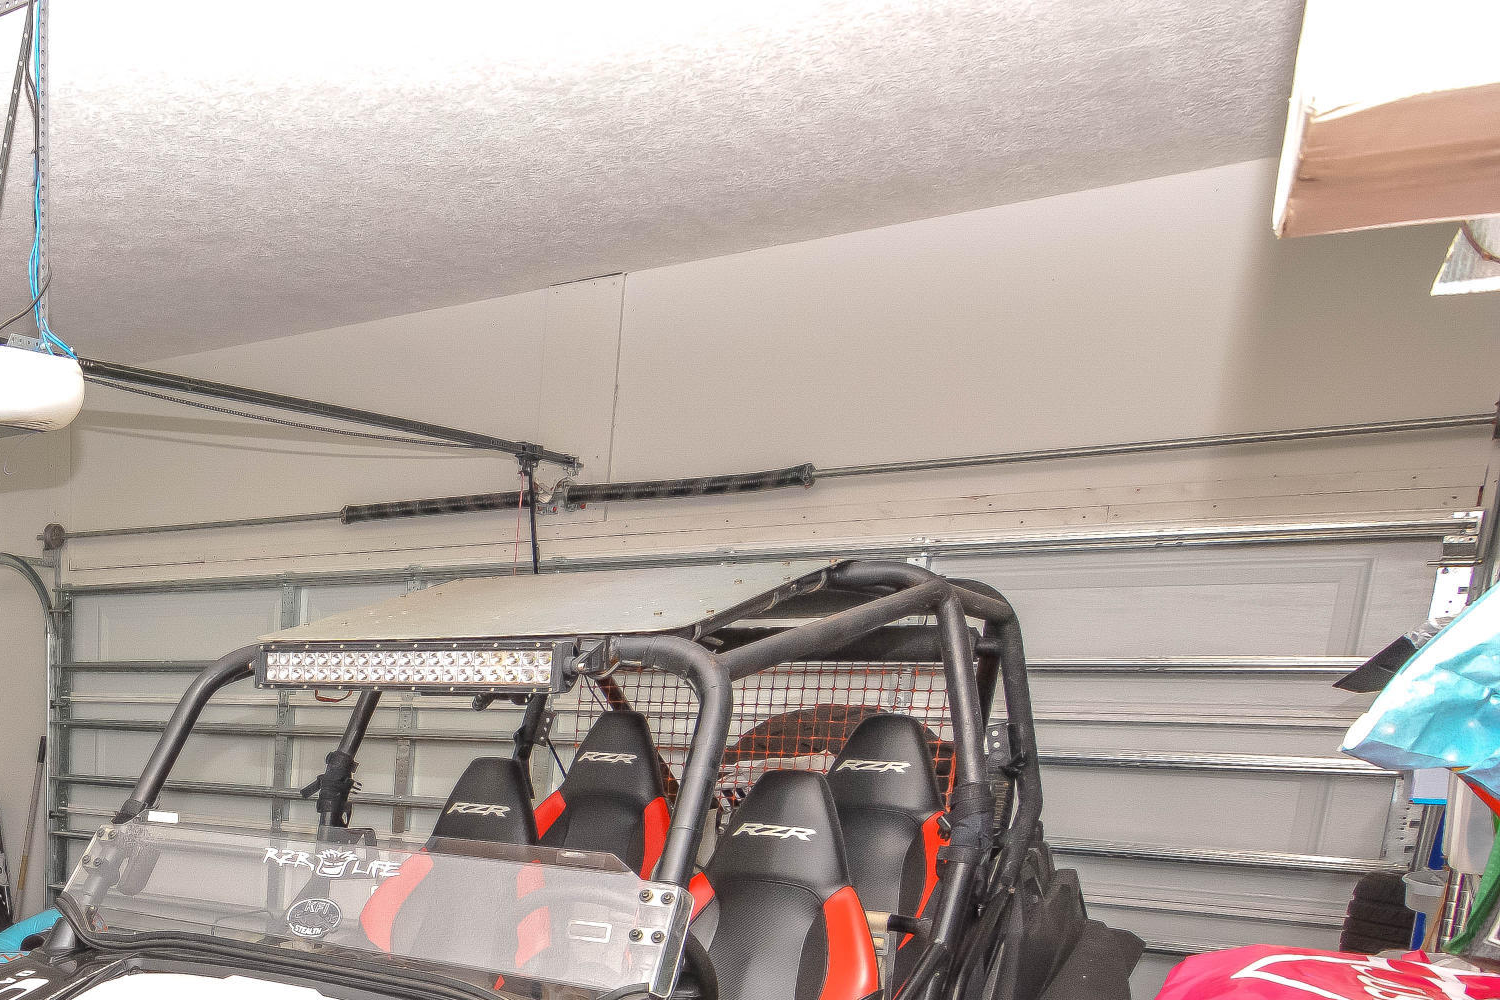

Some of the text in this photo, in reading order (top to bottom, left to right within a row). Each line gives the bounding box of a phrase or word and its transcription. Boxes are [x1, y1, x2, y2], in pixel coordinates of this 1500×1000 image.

[578, 751, 637, 764] RZR
[835, 759, 912, 774] RZR
[447, 802, 511, 817] RZR
[732, 822, 817, 841] RZR
[263, 847, 401, 878] RZR LIFE
[304, 900, 330, 913] KFI
[294, 924, 322, 936] STEALTH
